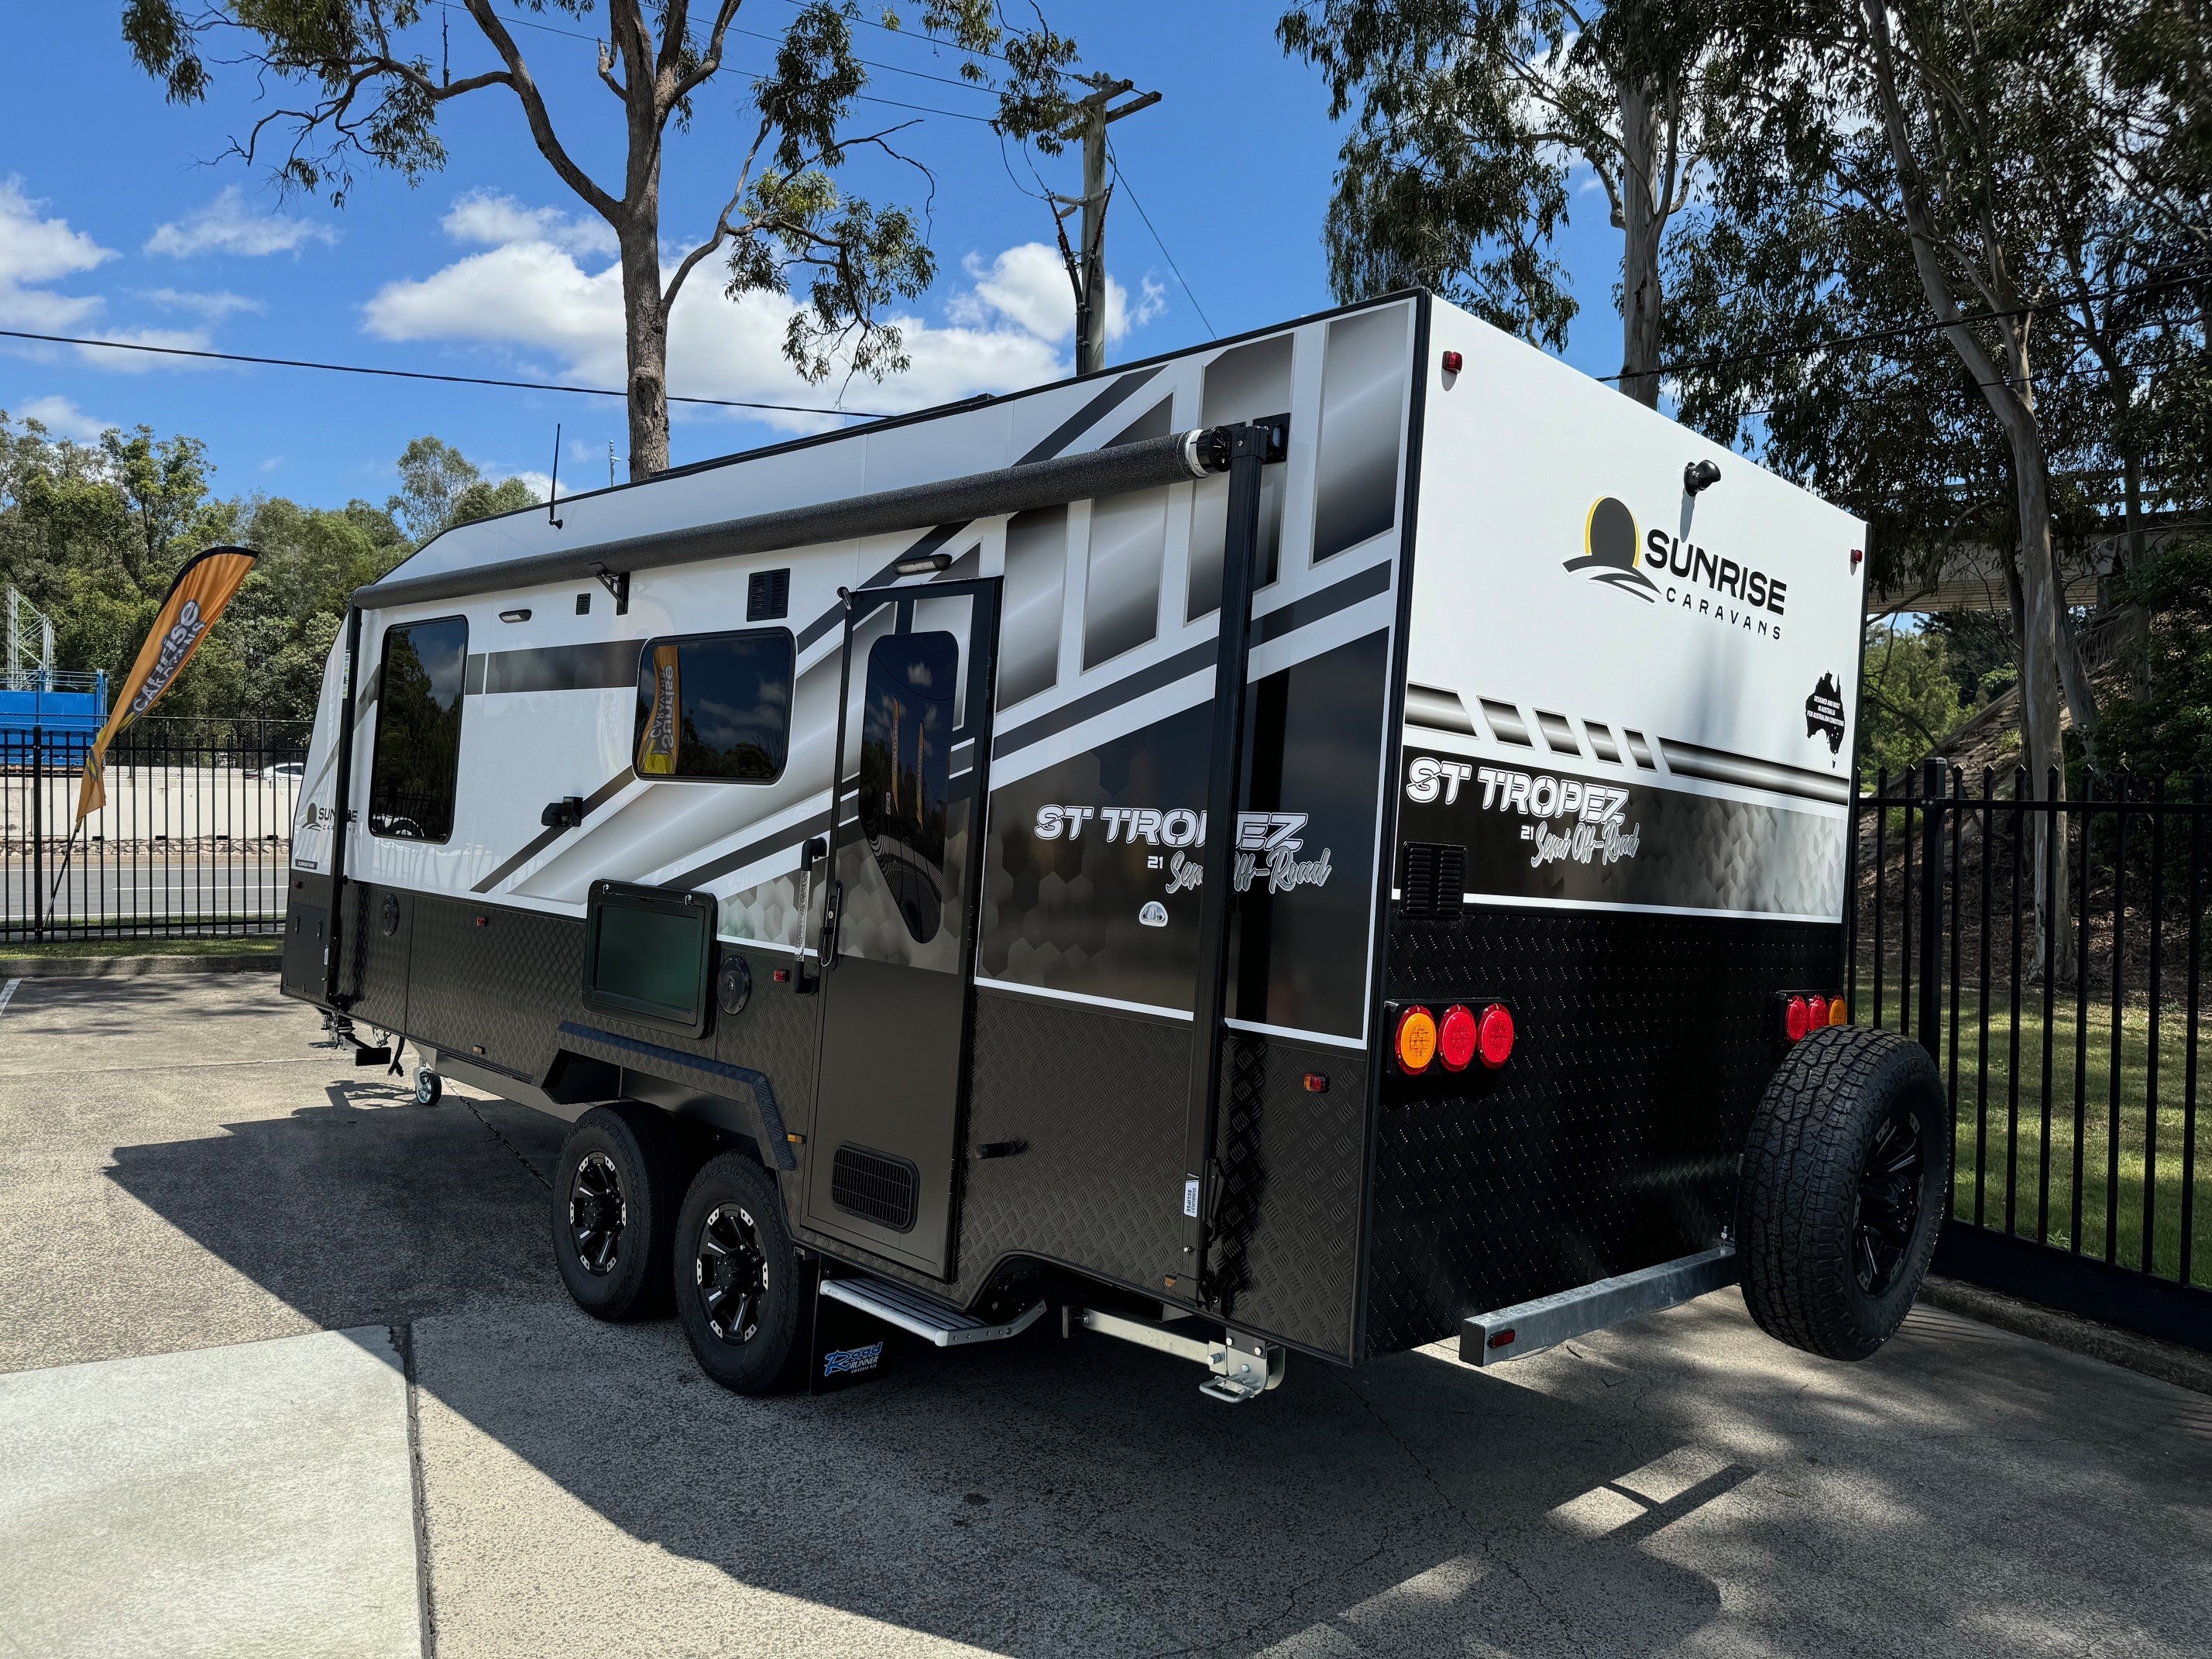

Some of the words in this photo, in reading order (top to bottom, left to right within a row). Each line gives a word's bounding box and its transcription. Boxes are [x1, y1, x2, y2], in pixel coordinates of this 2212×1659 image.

[1644, 529, 1788, 616] SUNRISE
[1666, 587, 1781, 641] CARAVANS
[1813, 712, 1829, 722] AUSTRALIAN
[1829, 716, 1844, 726] CONDITIONS
[1822, 706, 1836, 716] AUSTRALIA
[1406, 757, 1472, 805] ST
[1477, 766, 1630, 826] TROPEZ
[318, 808, 358, 823] SUNSE
[1035, 804, 1094, 841] ST
[1520, 825, 1534, 840] 21
[1530, 820, 1571, 867] Semi
[1572, 819, 1640, 866] Off-Road
[1147, 855, 1163, 870] 21
[1165, 850, 1204, 894] Sem
[1234, 846, 1332, 895] ff-Road
[824, 1341, 883, 1377] Road
[850, 1355, 879, 1369] RUNNER
